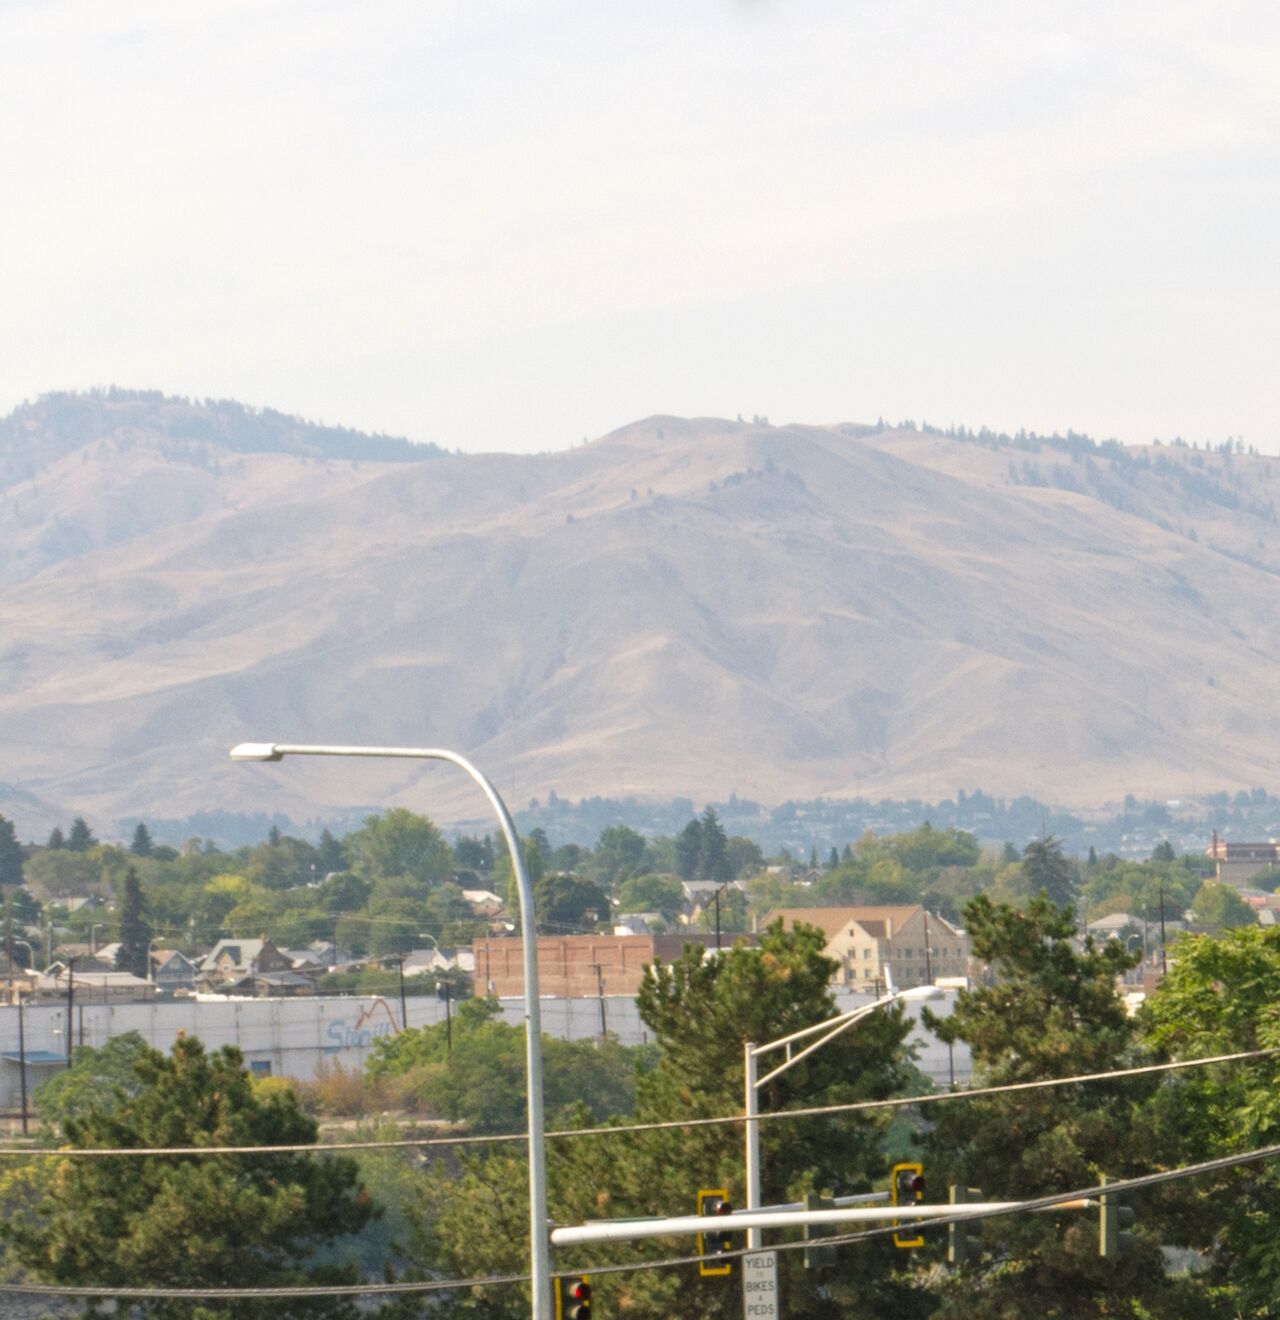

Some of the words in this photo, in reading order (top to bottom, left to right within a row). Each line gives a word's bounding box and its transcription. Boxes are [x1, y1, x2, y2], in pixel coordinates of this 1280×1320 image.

[745, 1257, 774, 1269] YIELD
[746, 1281, 775, 1293] BIKES
[747, 1304, 775, 1316] PEDS
